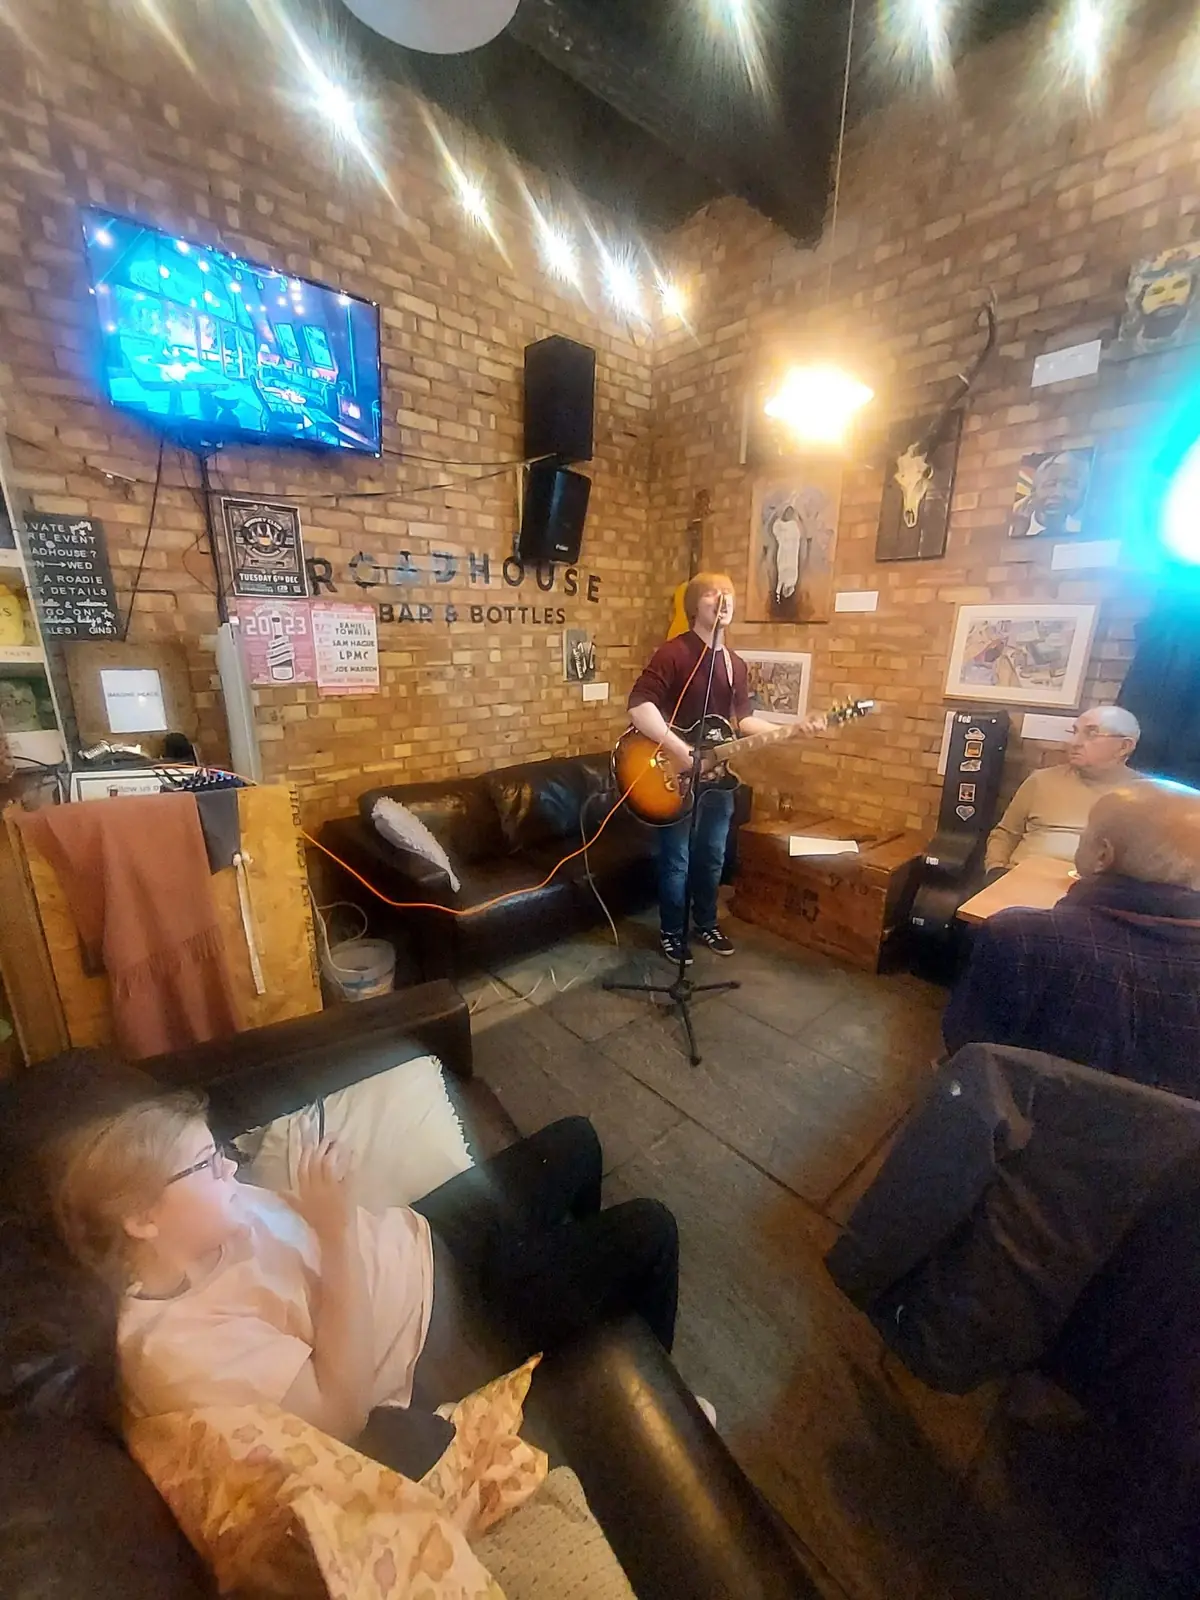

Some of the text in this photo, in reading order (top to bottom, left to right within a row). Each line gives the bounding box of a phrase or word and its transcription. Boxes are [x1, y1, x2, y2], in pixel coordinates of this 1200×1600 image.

[53, 533, 96, 544] EVENT
[66, 561, 93, 570] WED
[56, 574, 103, 584] ROADIE
[240, 573, 271, 582] TUESDAY
[285, 576, 298, 584] DEC
[306, 551, 601, 602] ROADHOUSE
[50, 586, 108, 596] DETAILS
[380, 603, 432, 624] BAR
[471, 606, 566, 625] BOTTLES
[339, 651, 369, 660] LPMC
